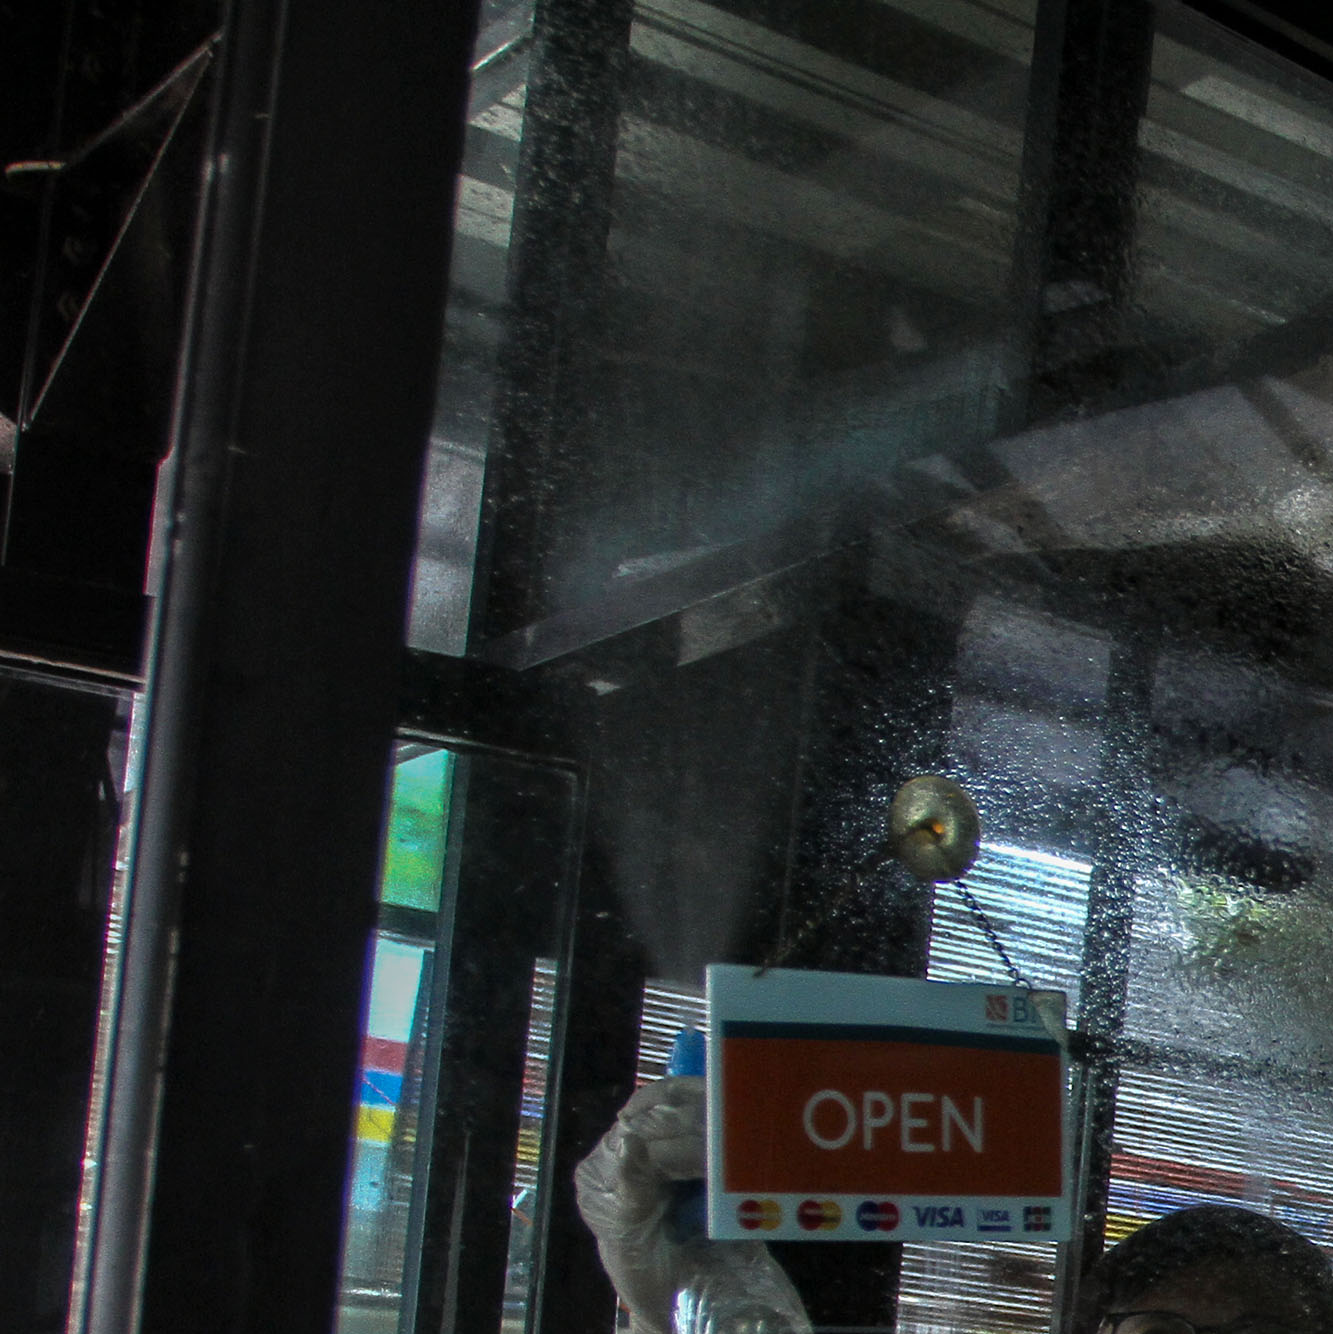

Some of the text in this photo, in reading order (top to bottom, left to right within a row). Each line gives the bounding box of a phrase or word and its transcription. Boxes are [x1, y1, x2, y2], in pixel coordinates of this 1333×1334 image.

[803, 1088, 985, 1154] OPEN
[912, 1205, 965, 1229] VISA
[981, 1209, 1011, 1223] VISA
